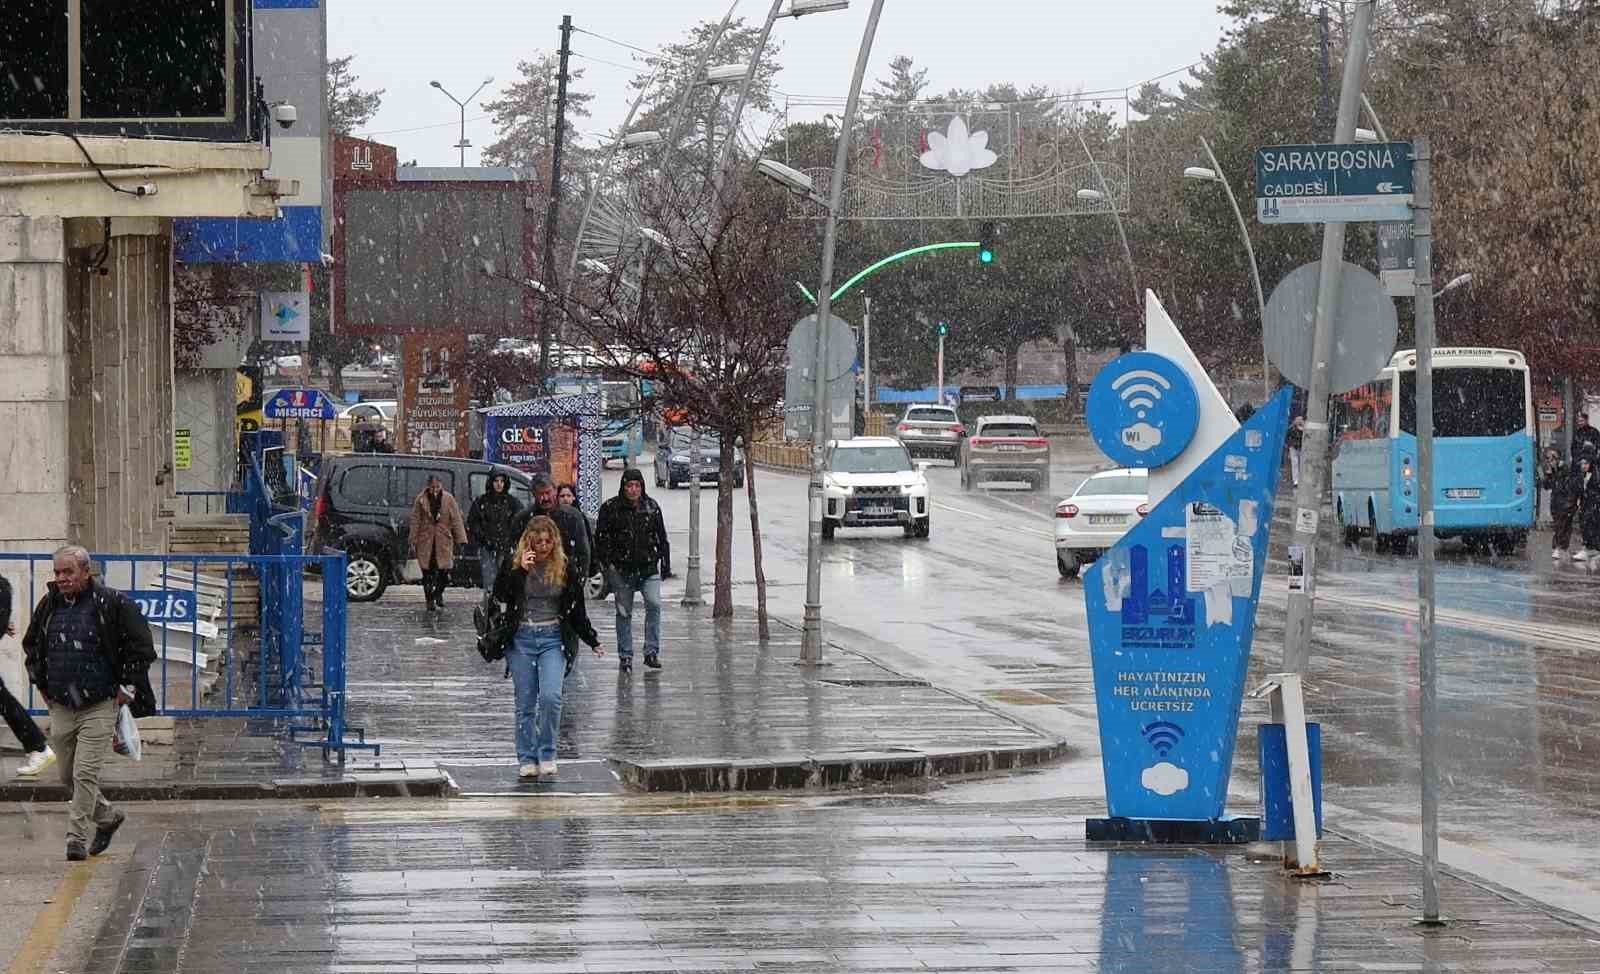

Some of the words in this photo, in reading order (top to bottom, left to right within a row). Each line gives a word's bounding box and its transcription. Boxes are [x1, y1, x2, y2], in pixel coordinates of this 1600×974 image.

[1263, 150, 1395, 172] SARAYBOSNA
[1264, 181, 1328, 196] CADDESİ
[134, 594, 188, 618] OLİS
[1118, 671, 1206, 683] HAYATINIZIN
[1113, 685, 1138, 697] HER
[1143, 687, 1212, 698] ALANINDA
